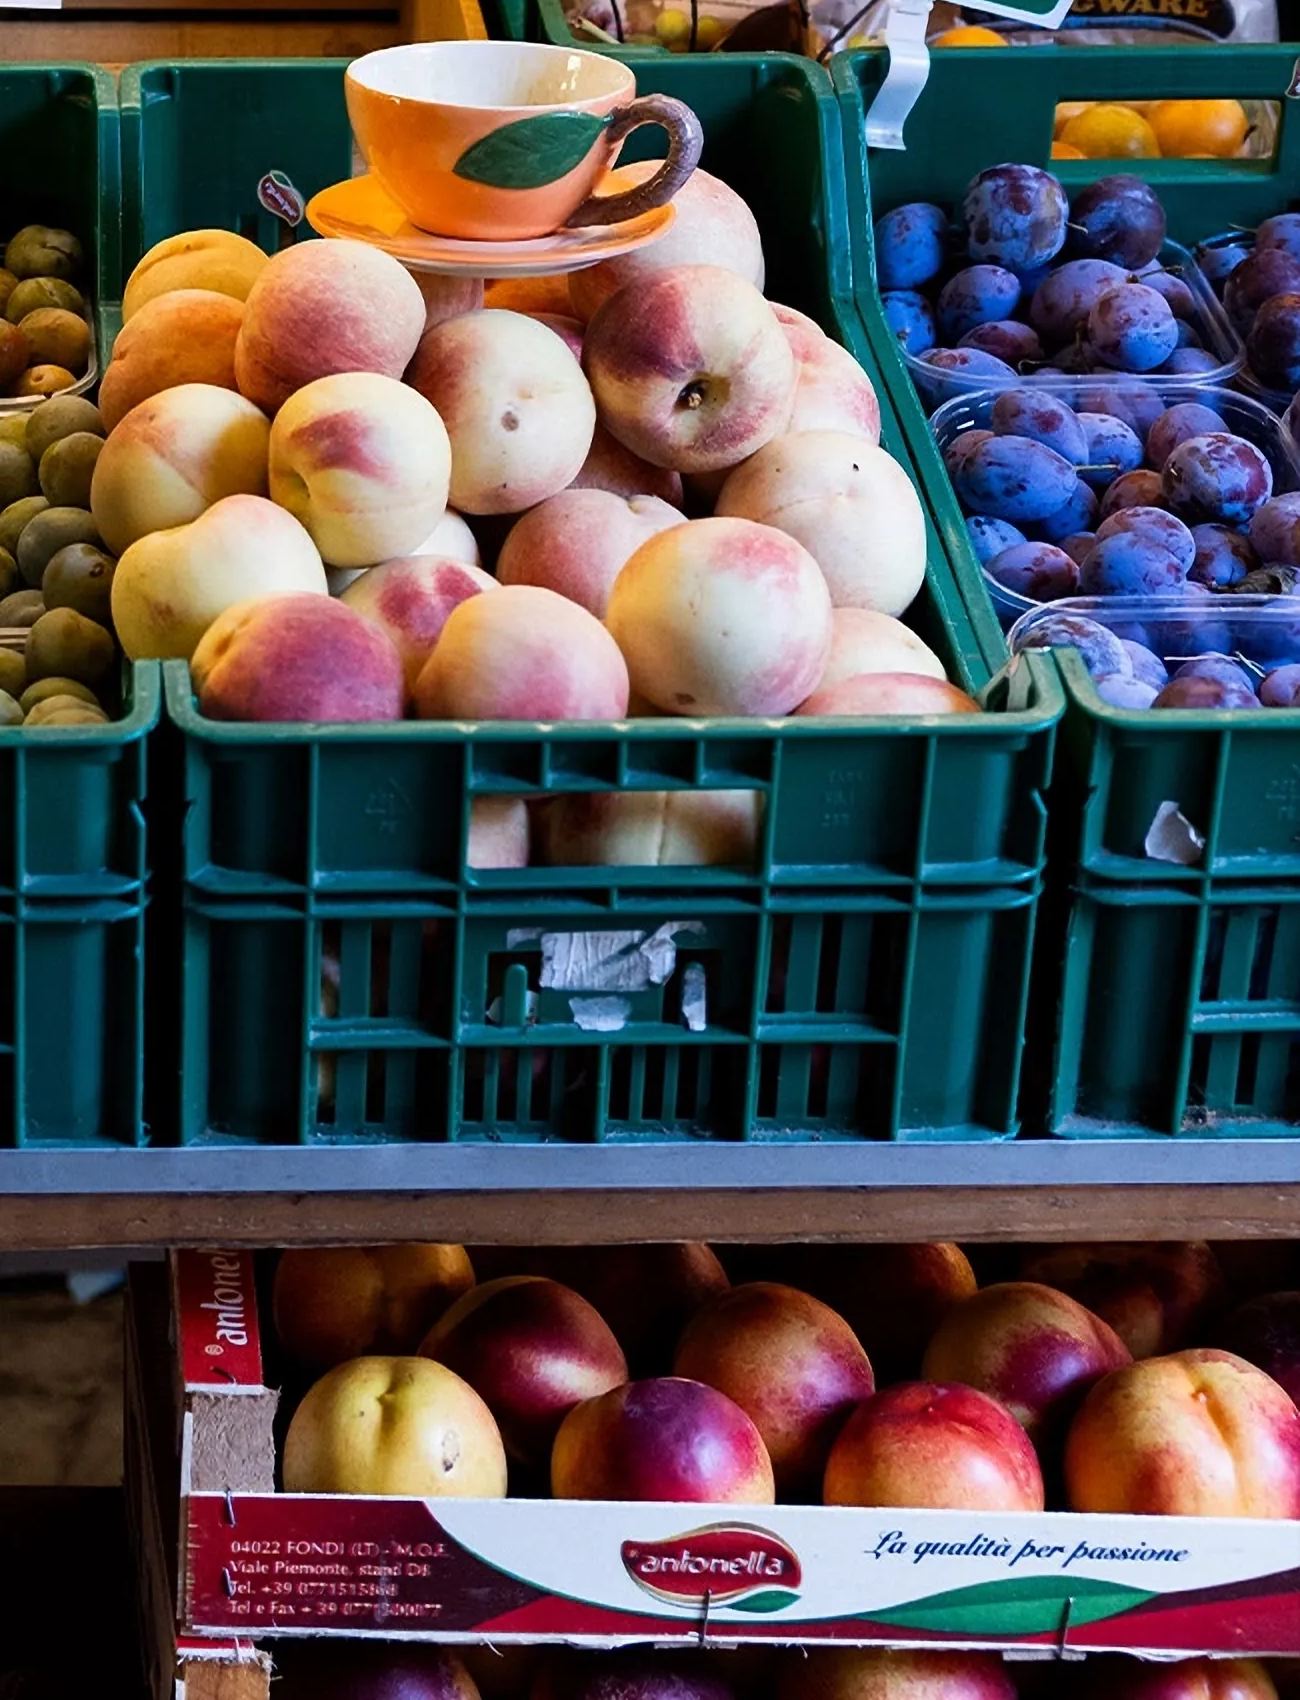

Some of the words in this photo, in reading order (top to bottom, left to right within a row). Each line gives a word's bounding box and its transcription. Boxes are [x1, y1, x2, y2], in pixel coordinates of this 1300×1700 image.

[230, 1540, 281, 1555] 04022
[287, 1541, 345, 1555] FONDI
[351, 1542, 380, 1556] (LT)
[864, 1530, 908, 1560] La
[913, 1533, 1013, 1564] qualità
[1008, 1538, 1065, 1567] per
[1061, 1540, 1189, 1568] passione
[229, 1560, 269, 1574] Viale
[640, 1548, 785, 1576] antonella
[230, 1582, 255, 1595] Tel.
[229, 1601, 251, 1614] Tel
[270, 1601, 296, 1615] Fax
